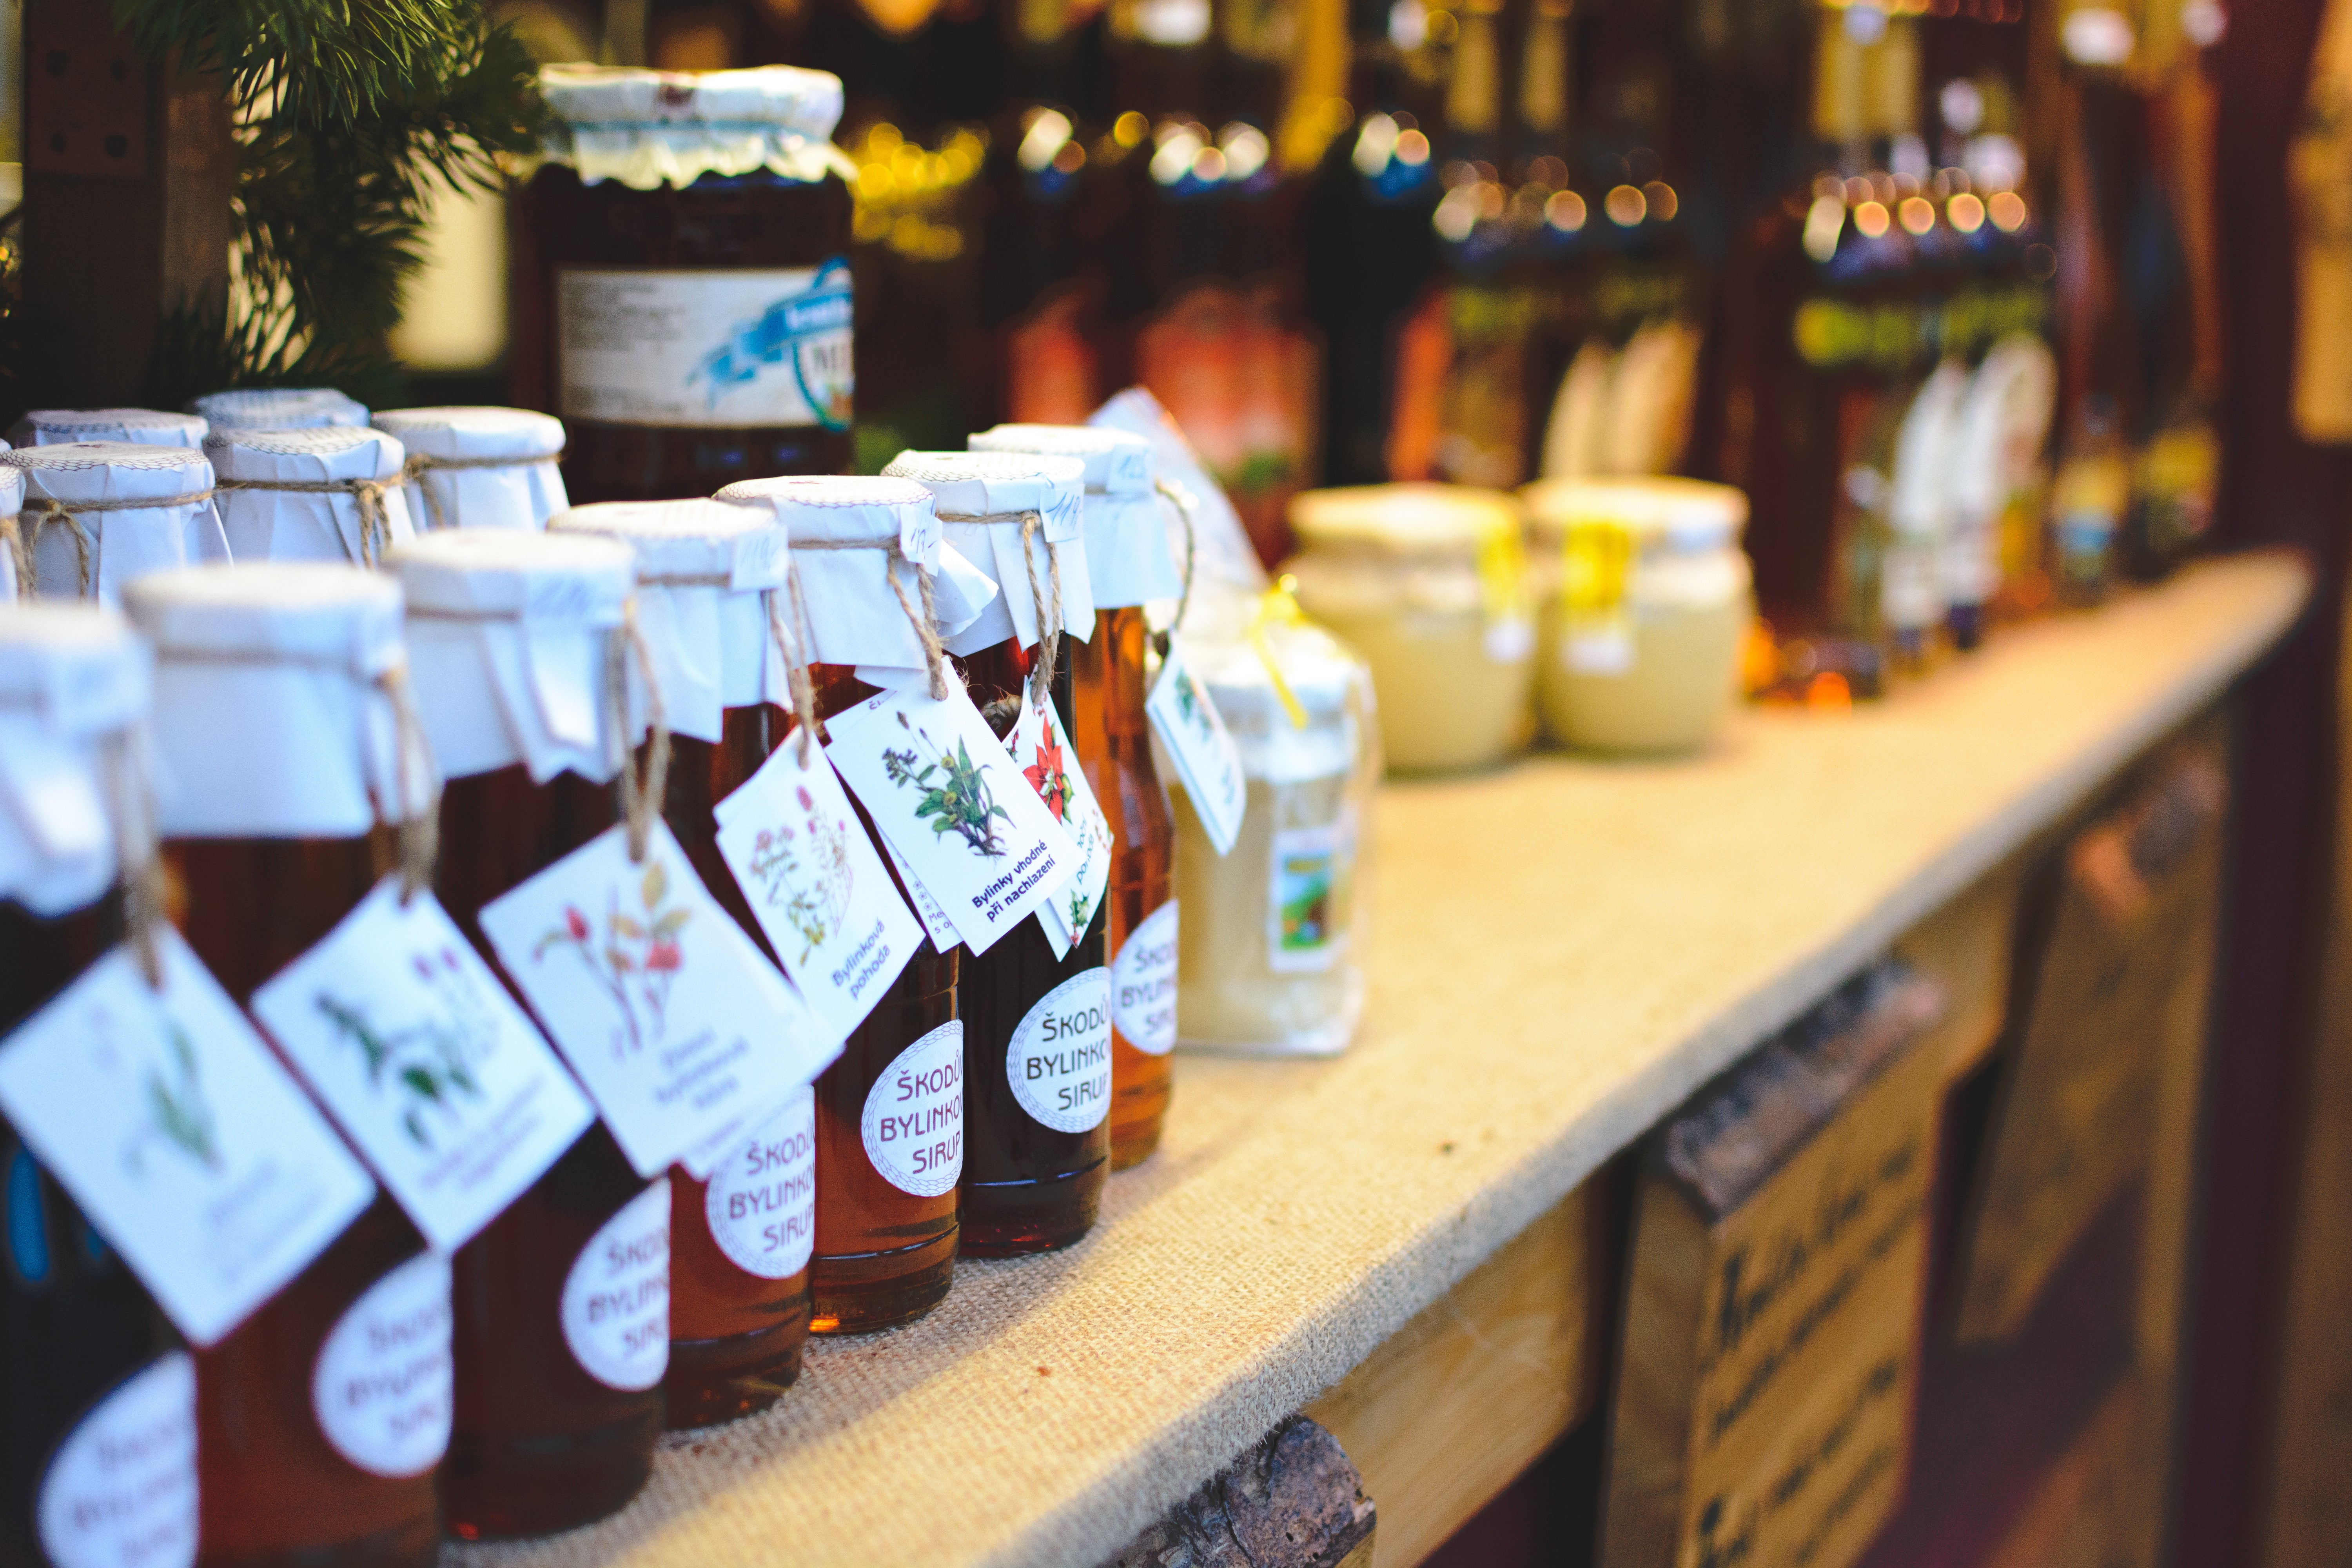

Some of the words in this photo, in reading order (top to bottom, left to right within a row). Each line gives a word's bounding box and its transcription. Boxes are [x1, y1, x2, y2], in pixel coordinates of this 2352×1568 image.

[972, 872, 1014, 908] Bylinky
[1014, 839, 1048, 875] vhodné
[986, 900, 1004, 923] při
[1004, 854, 1056, 906] nachlazení
[831, 916, 885, 987] Bylinková
[850, 944, 891, 1000] pohoda
[1042, 993, 1109, 1042] ŠKODŮ
[1027, 1037, 1109, 1080] BYLINKO
[912, 1130, 960, 1174] SIRUP
[729, 1160, 814, 1220] BYLINKO
[763, 1203, 813, 1253] SIRUP
